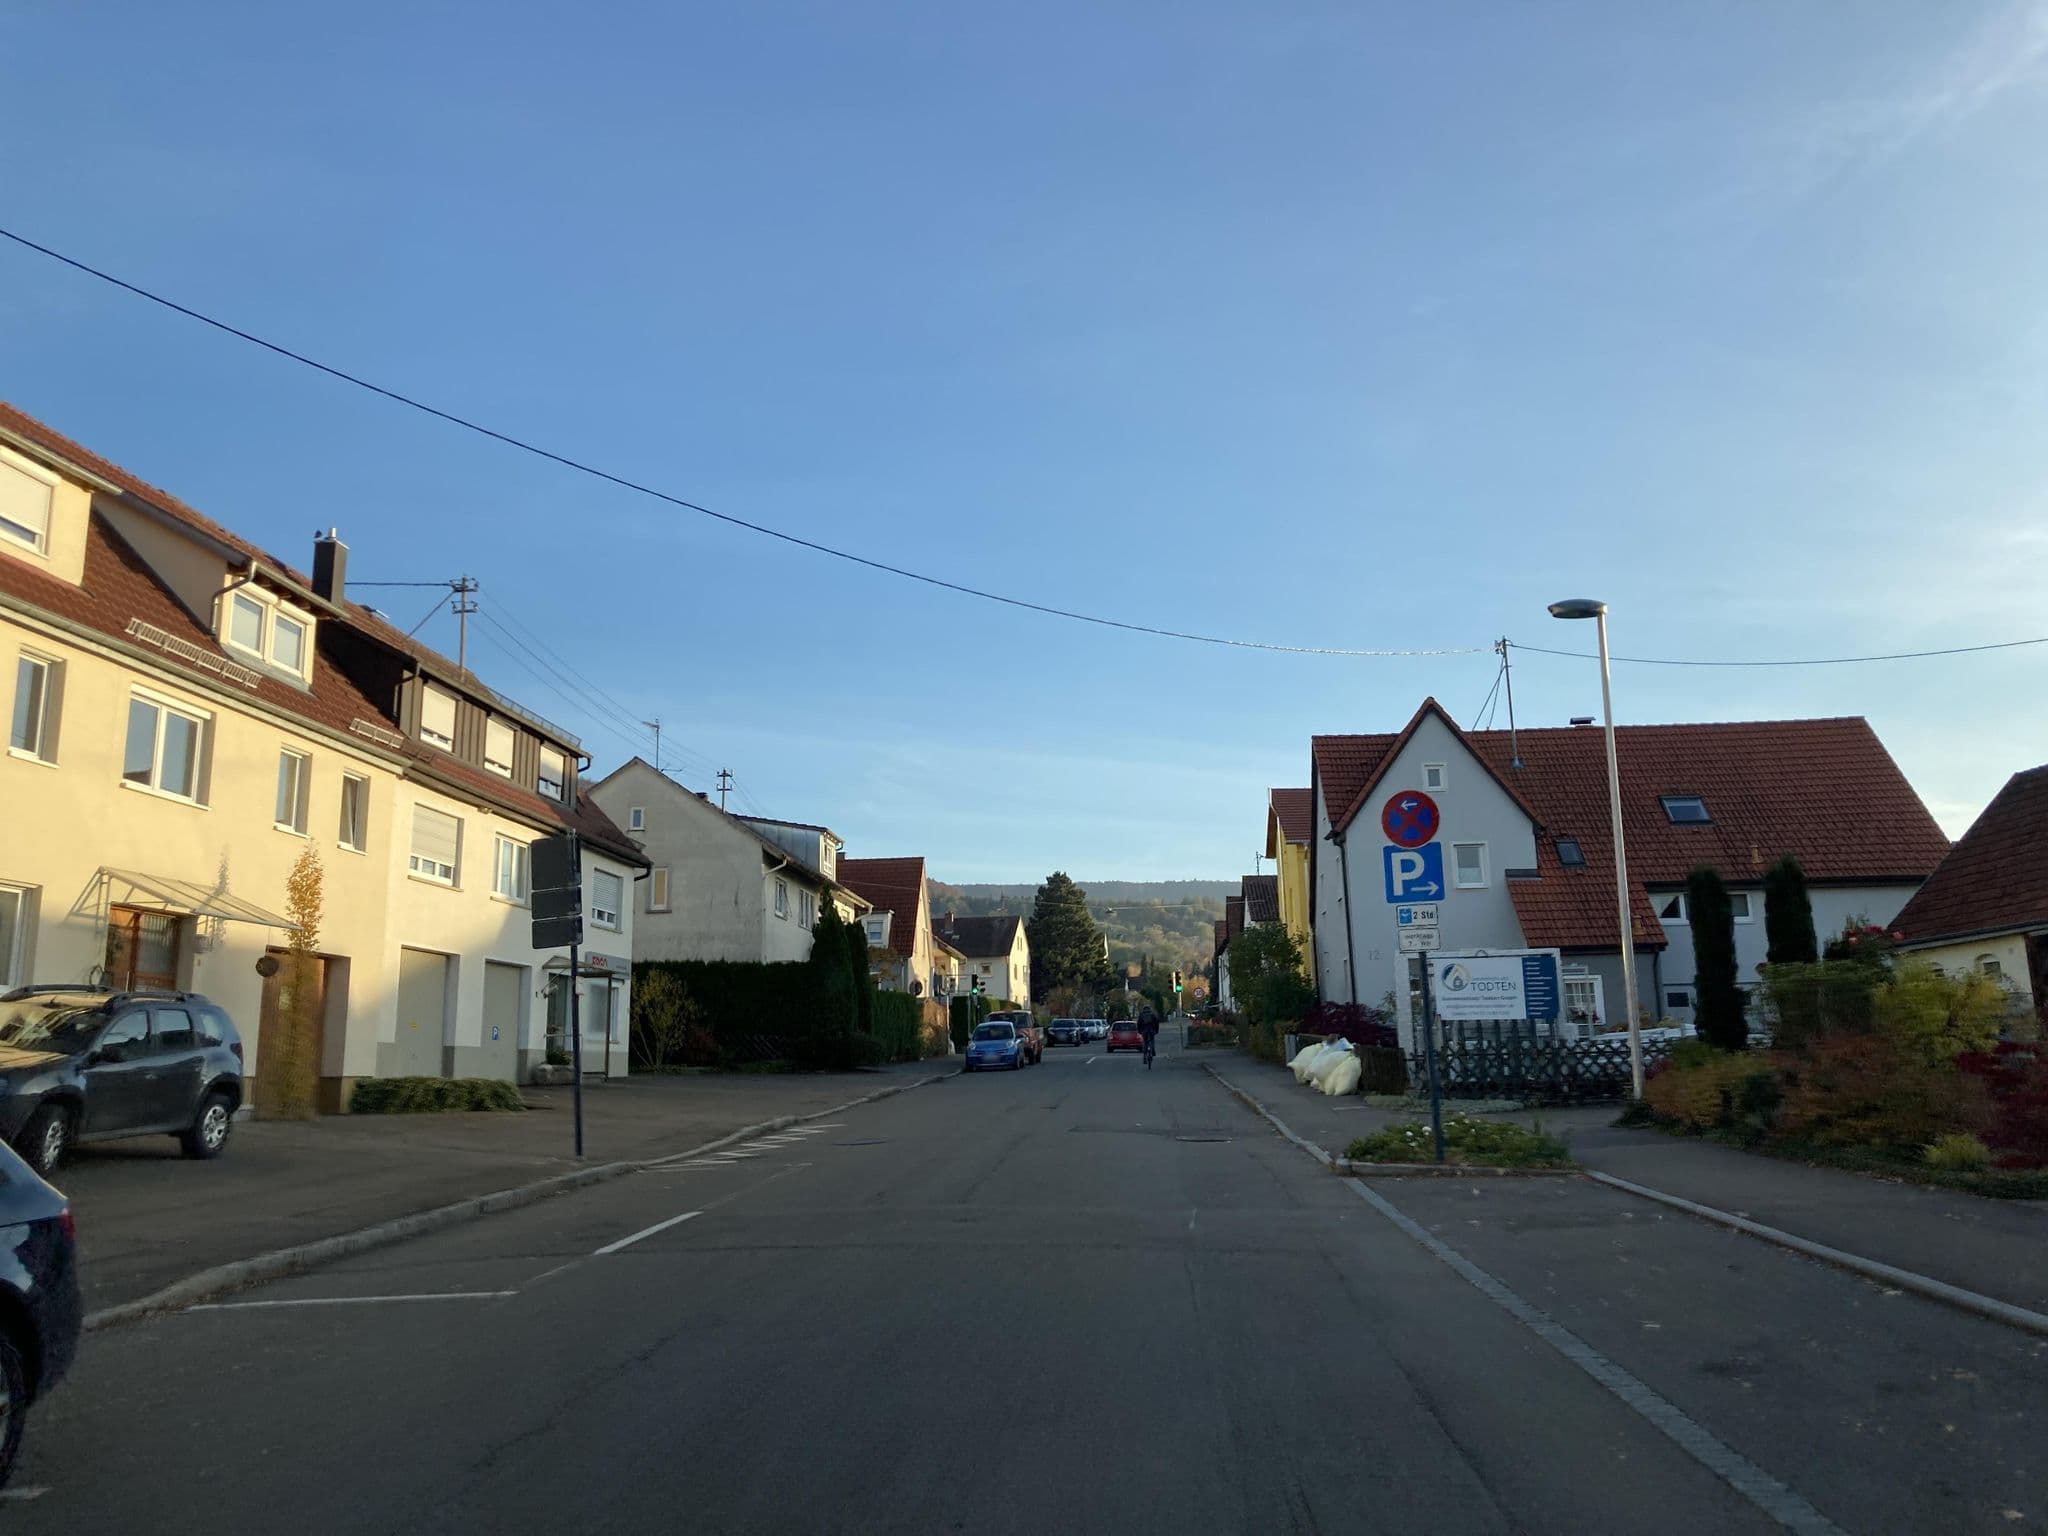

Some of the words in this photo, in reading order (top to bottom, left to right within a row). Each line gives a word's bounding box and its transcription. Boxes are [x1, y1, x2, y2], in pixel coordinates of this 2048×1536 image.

[1390, 851, 1425, 896] P
[1413, 911, 1418, 919] 2
[1470, 981, 1517, 992] TODTEN
